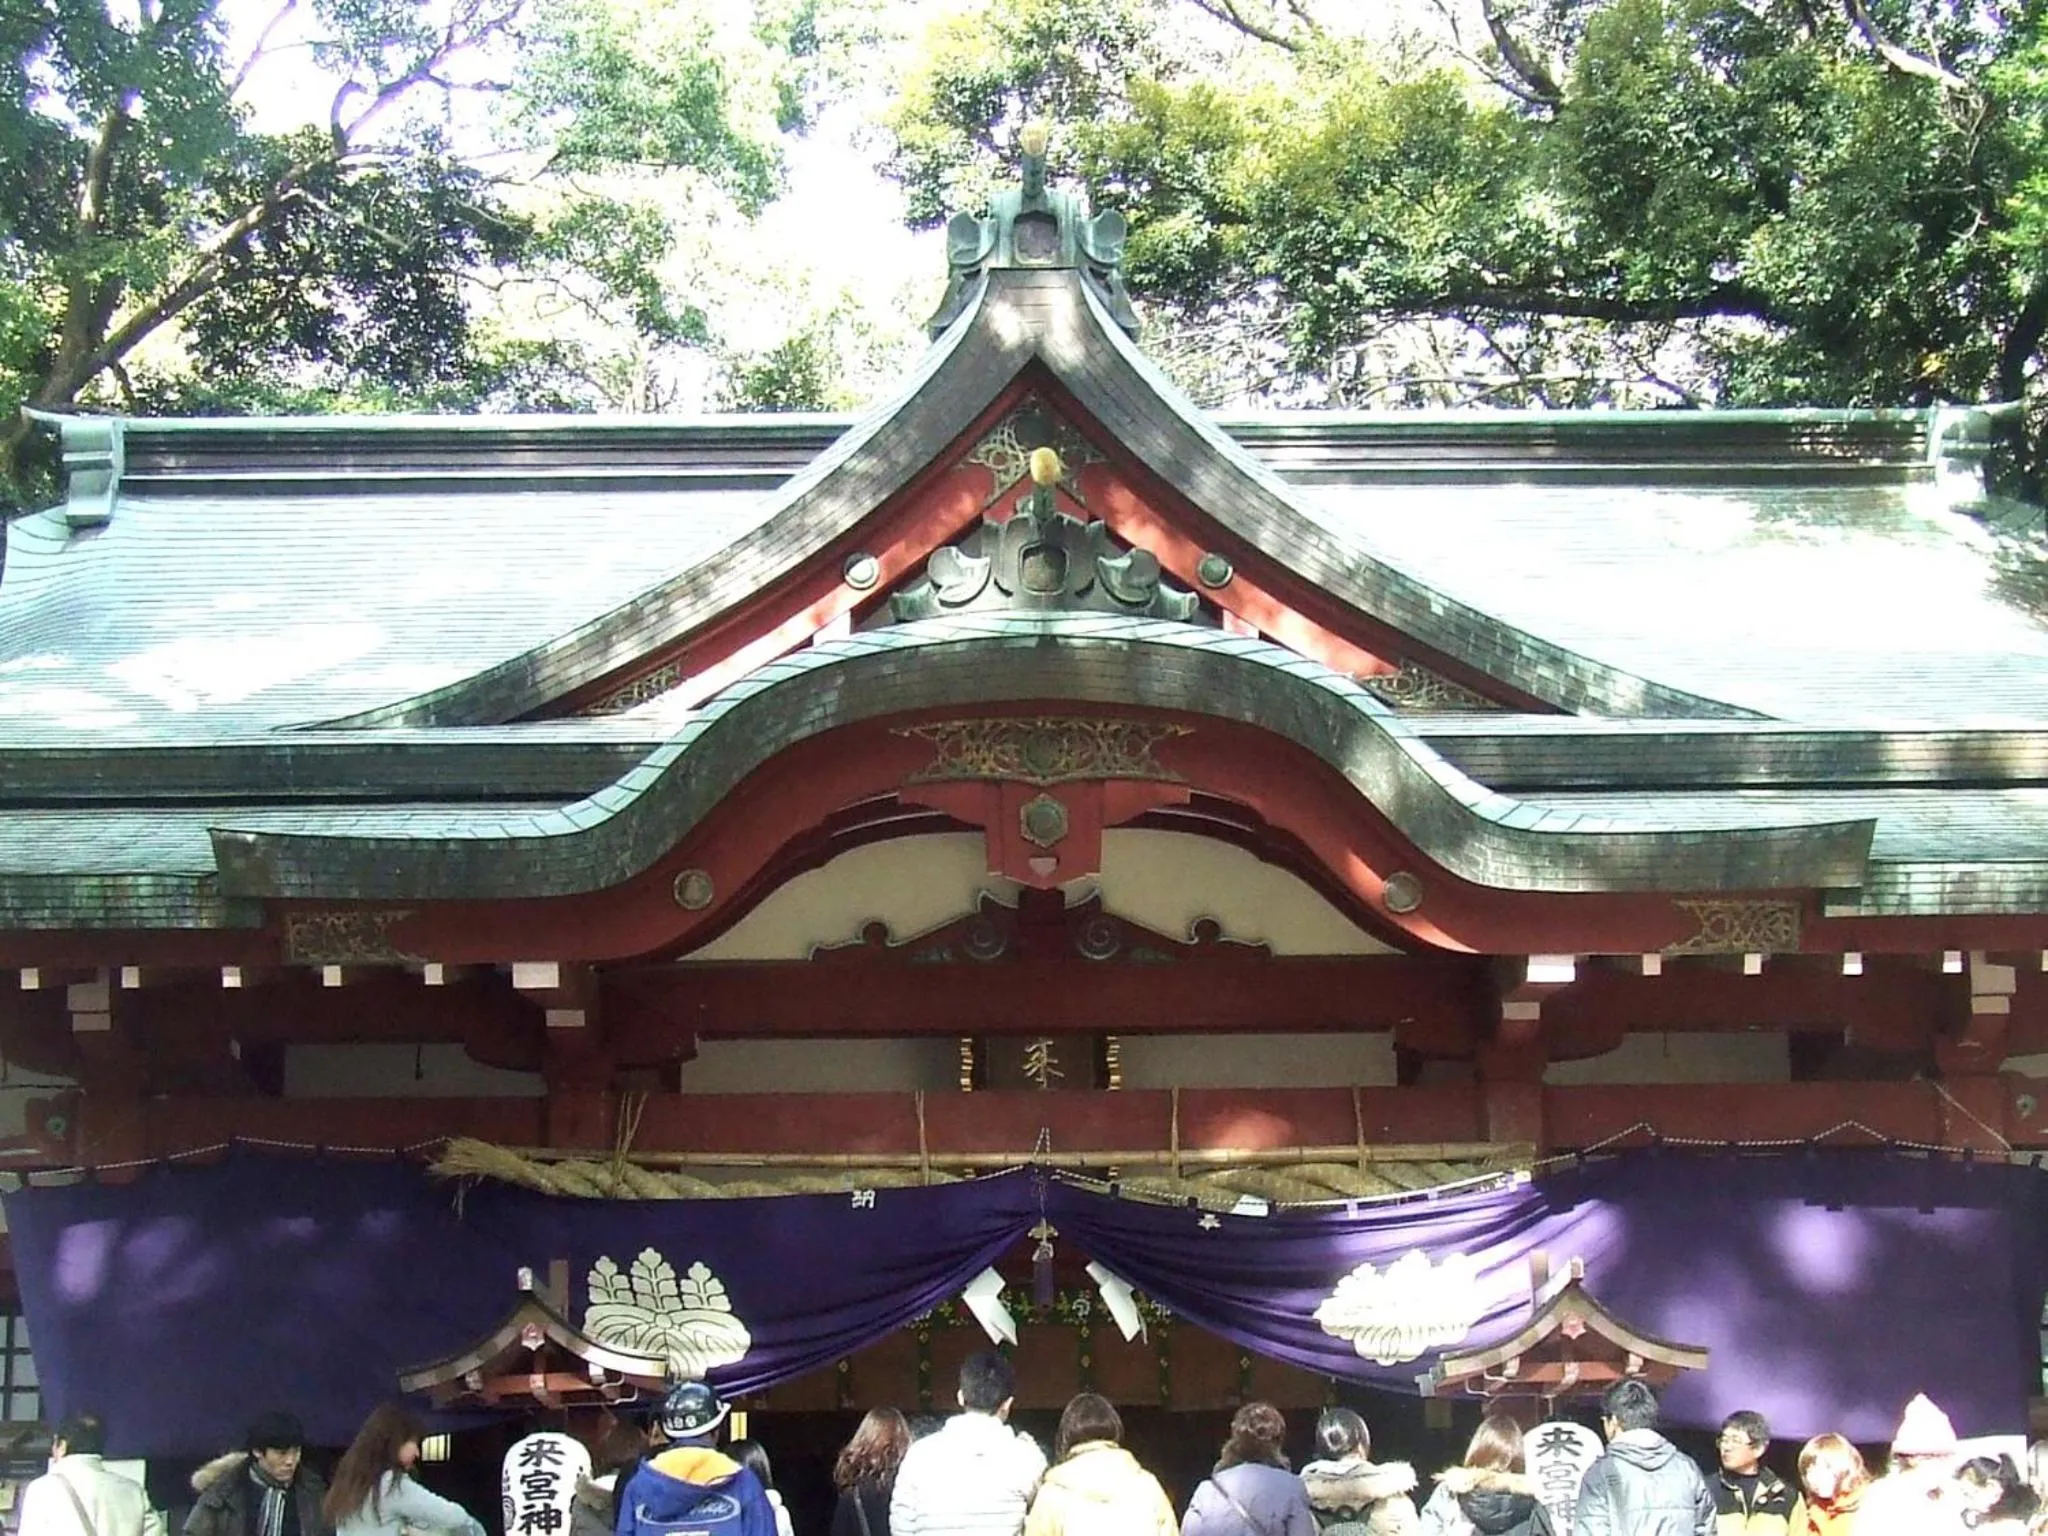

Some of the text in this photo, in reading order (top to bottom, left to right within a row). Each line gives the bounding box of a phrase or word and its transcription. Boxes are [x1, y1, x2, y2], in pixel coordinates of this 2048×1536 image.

[518, 1439, 566, 1535] 来宮神
[1536, 1427, 1584, 1536] 来宮神
